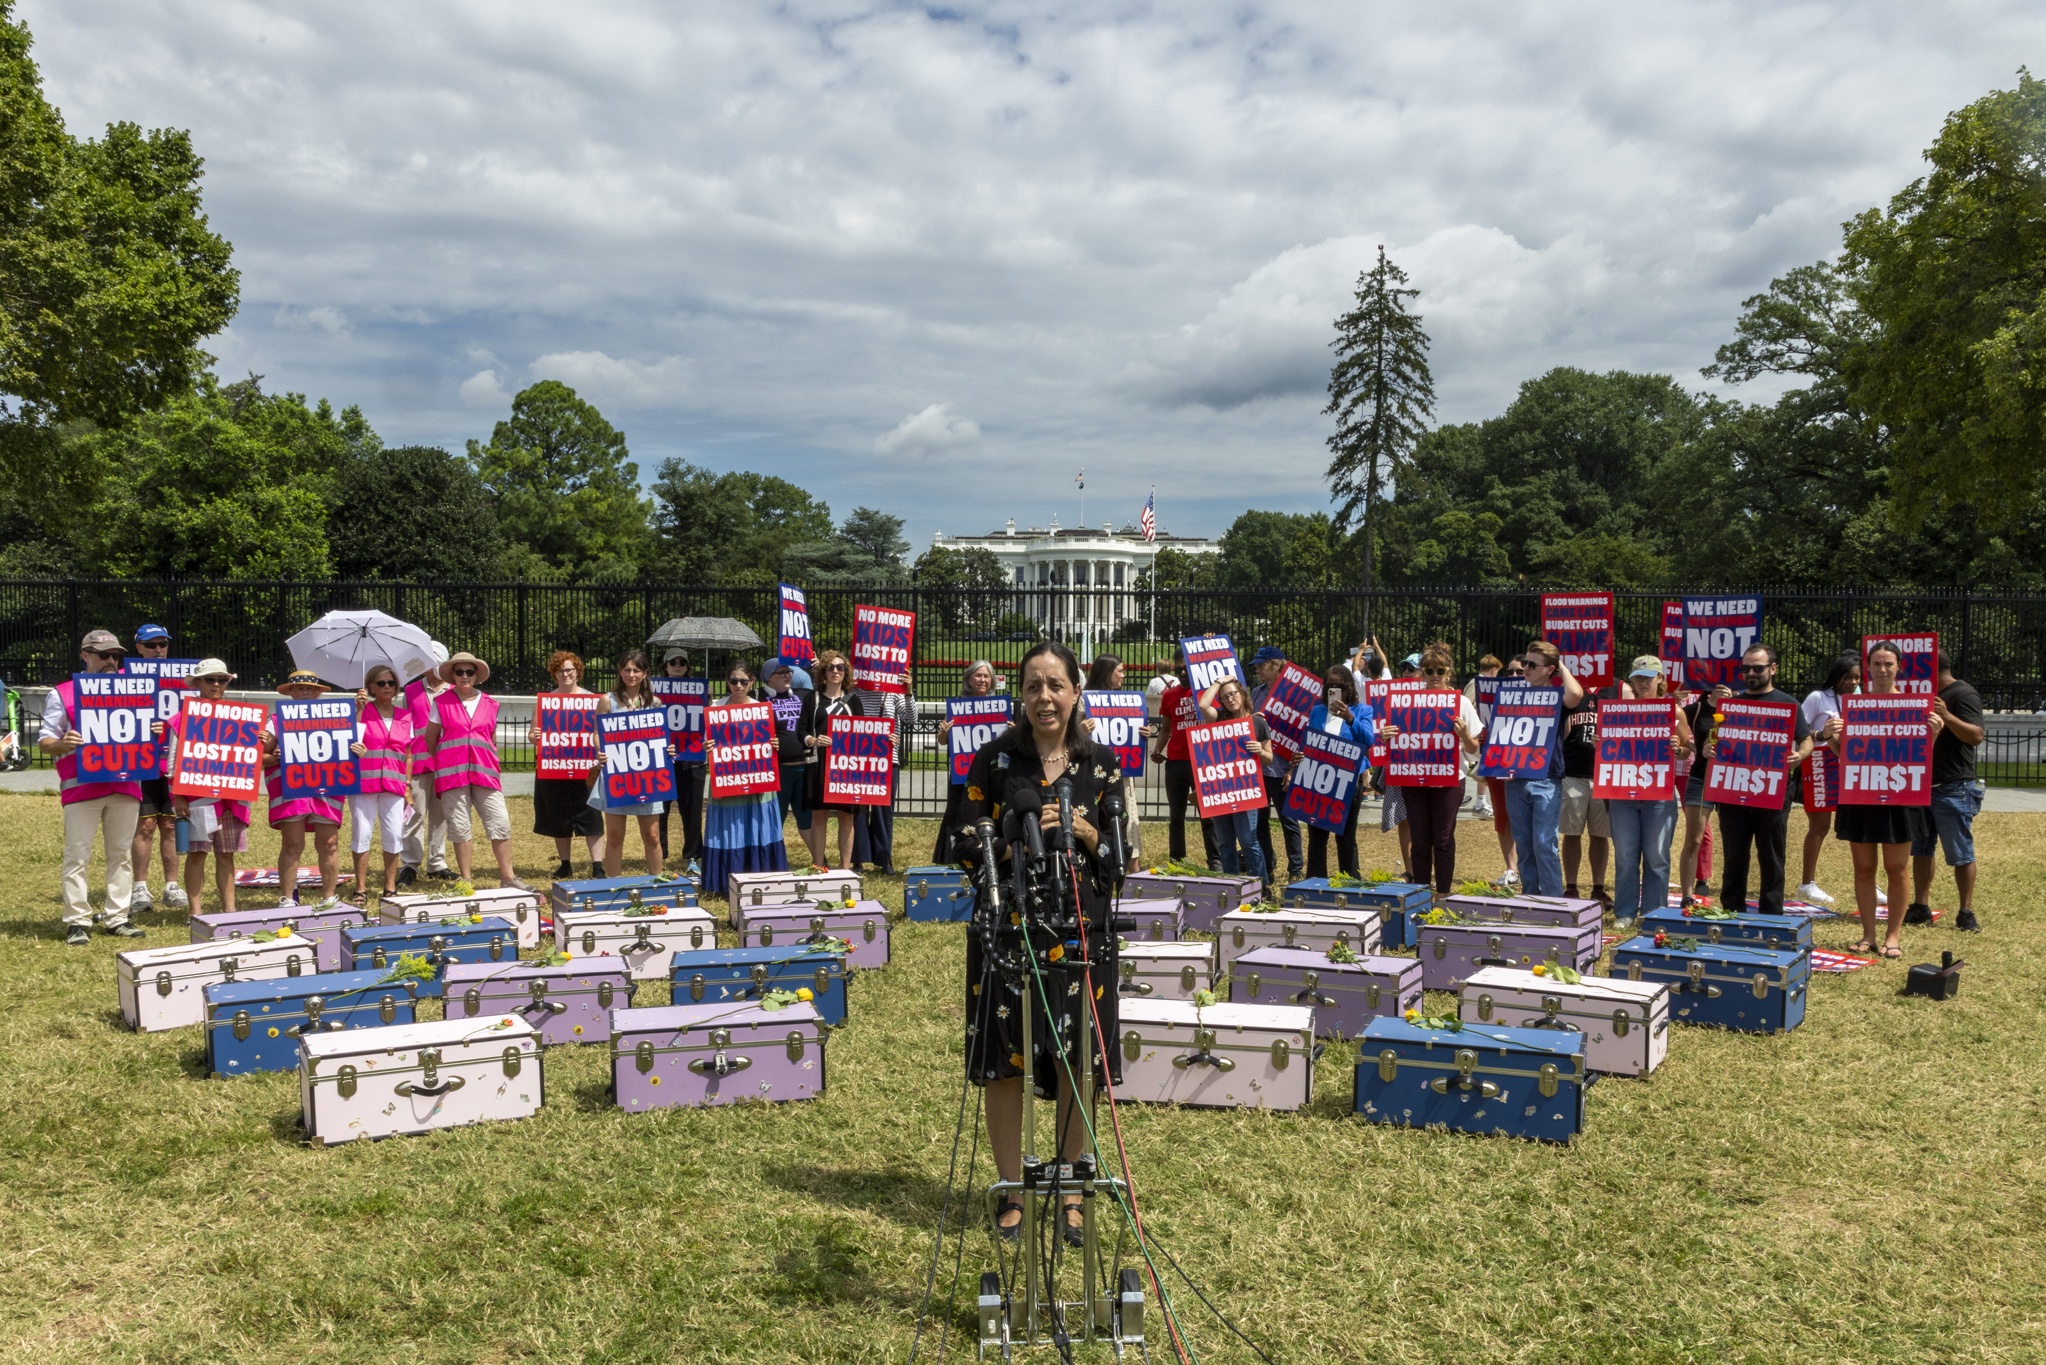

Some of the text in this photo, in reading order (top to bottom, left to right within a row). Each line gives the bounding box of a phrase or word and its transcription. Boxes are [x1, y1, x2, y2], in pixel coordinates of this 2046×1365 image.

[782, 586, 804, 604] WE NEED
[1546, 608, 1574, 618] CAME
[1688, 600, 1756, 615] WE NEED
[782, 609, 810, 639] NOT
[859, 609, 911, 628] NO MORE
[1546, 620, 1608, 630] BUDGET CUTS
[856, 622, 908, 648] KIDS
[1664, 628, 1682, 637] BUD
[781, 636, 814, 660] CUTS
[1184, 638, 1229, 654] WE NEED
[1687, 627, 1756, 658] NOT
[856, 644, 907, 663] LOST TO
[130, 662, 157, 674] WE
[1688, 659, 1743, 683] CUT
[80, 679, 111, 694] WE
[114, 679, 154, 694] NEED
[651, 681, 704, 694] WE NEED
[1284, 666, 1322, 696] NO MO
[1370, 684, 1388, 696] NO
[1910, 680, 1932, 693] TO
[542, 698, 560, 710] NO
[951, 700, 1006, 715] WE NEED
[1087, 694, 1142, 706] WE NEED
[1181, 697, 1193, 706] FUN
[1391, 694, 1456, 707] NO MORE
[1500, 692, 1524, 704] WE
[1523, 692, 1559, 705] NEED
[1848, 699, 1928, 708] FLOOD WARNINGS
[188, 701, 212, 716] NO
[215, 704, 262, 722] MORE
[282, 703, 350, 719] WE NEED
[666, 704, 703, 731] OT
[709, 706, 769, 724] NO MORE
[779, 710, 800, 718] PAY
[1265, 698, 1309, 730] LOST T
[1391, 708, 1454, 732] KIDS
[1572, 712, 1597, 726] HOUST
[1604, 714, 1636, 724] CAME
[1722, 704, 1791, 717] FLOOD WARNINGS
[1848, 710, 1886, 722] CAME
[81, 709, 154, 743] NOT
[186, 716, 260, 747] KIDS
[602, 713, 664, 732] WE NEED
[832, 719, 890, 734] NO MORE
[1092, 718, 1144, 745] NOT
[1489, 717, 1554, 746] NOT
[1602, 727, 1670, 737] BUDGET CUTS
[1847, 725, 1926, 736] BUDGET CUTS
[542, 732, 578, 746] LOST
[711, 720, 770, 747] KIDS
[1191, 722, 1250, 743] NO MORE
[1390, 733, 1454, 749] LOST TO
[1583, 726, 1594, 742] 13
[1718, 728, 1788, 744] BUDGET CUTS
[183, 741, 257, 763] LOST TO
[284, 730, 353, 762] NOT
[670, 732, 703, 753] TS
[832, 732, 889, 757] KIDS
[1195, 736, 1253, 767] KIDS
[1307, 731, 1360, 760] WE NEED
[1602, 740, 1671, 761] CAME
[1847, 738, 1926, 762] CAME
[82, 743, 154, 772] CUTS
[604, 738, 667, 774] NOT
[712, 743, 772, 763] LOST TO
[1391, 749, 1454, 764] CLIMATE
[1485, 746, 1547, 769] CUTS
[1715, 740, 1786, 768] CAME
[182, 758, 254, 778] CLIMATE
[715, 758, 773, 776] CLIMATE
[830, 755, 888, 772] LOST TO
[1198, 759, 1256, 782] LOST TO
[1390, 764, 1454, 776] DISASTERS
[180, 772, 254, 790] DISASTERS
[286, 762, 354, 788] CUTS
[609, 769, 671, 797] CUTS
[716, 771, 774, 787] DISASTERS
[830, 769, 886, 785] CLIMATE
[1294, 757, 1354, 800] NOT
[1812, 750, 1826, 807] DISASTERS
[829, 783, 886, 796] DISASTERS
[1202, 774, 1258, 796] CLIMATE
[1203, 788, 1261, 807] DISASTERS
[1288, 787, 1345, 824] CUTS
